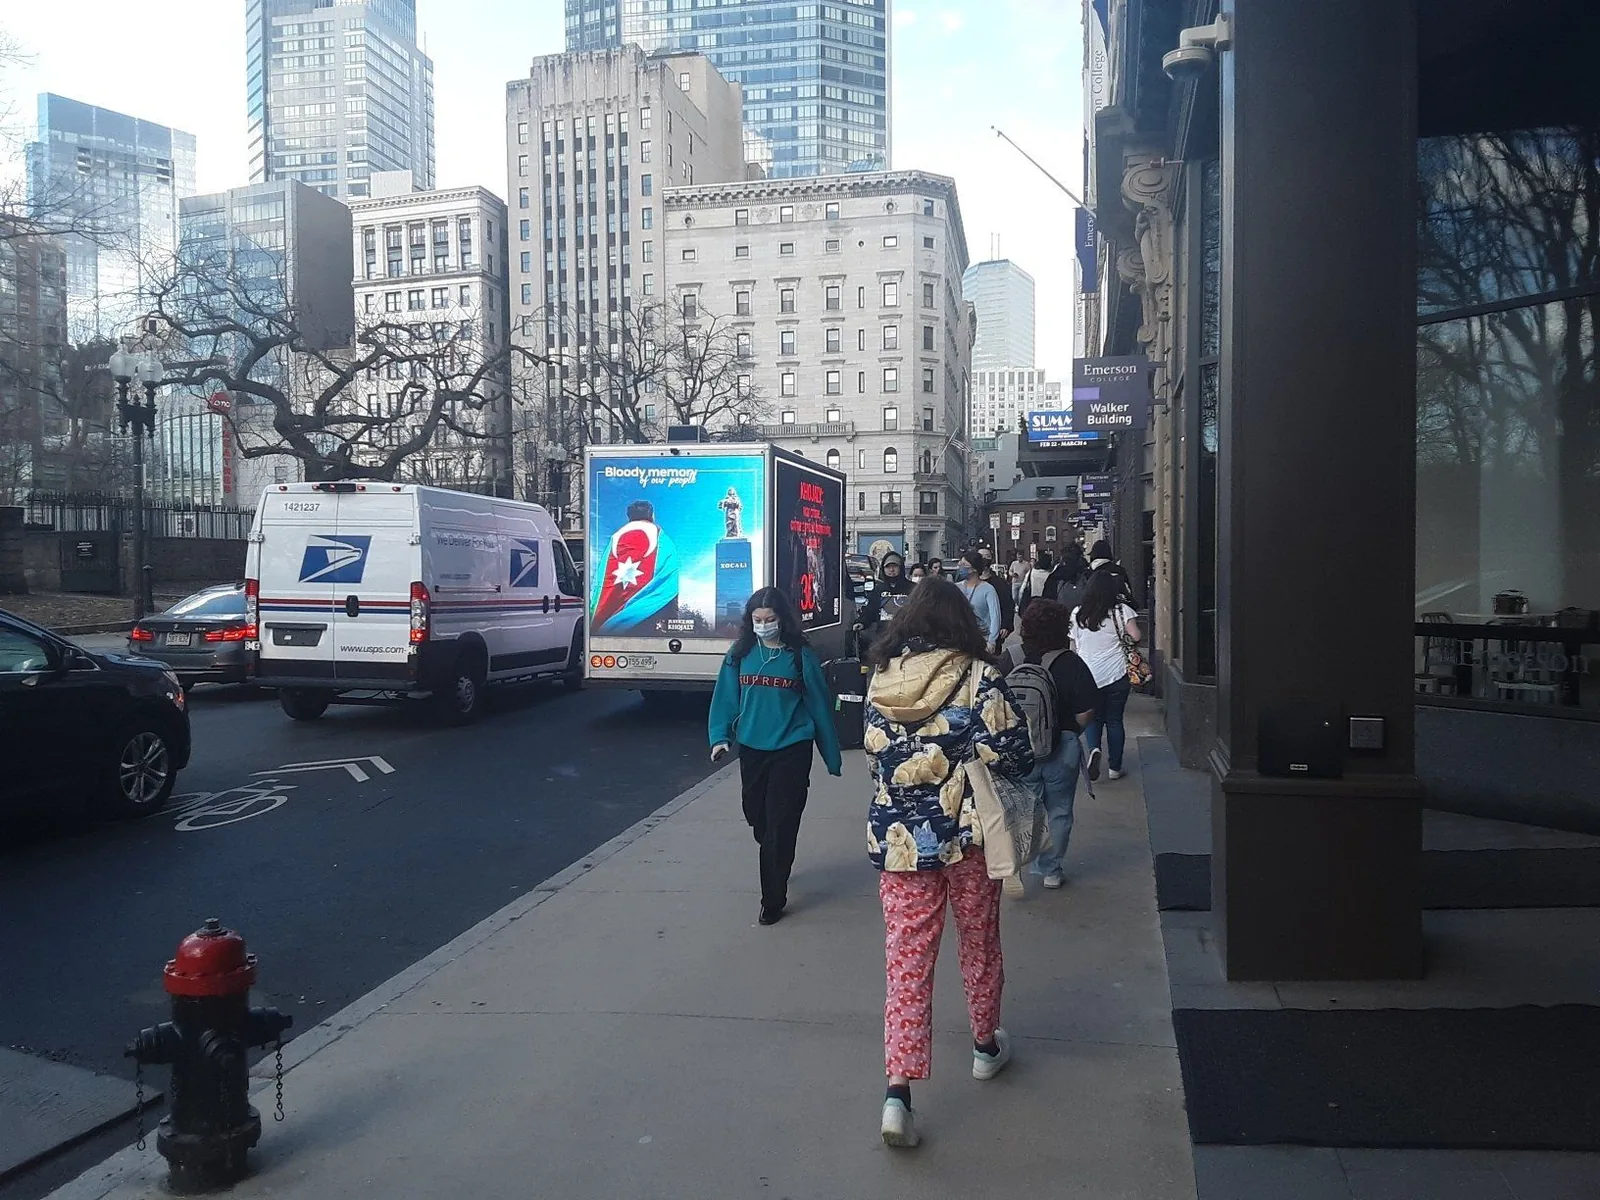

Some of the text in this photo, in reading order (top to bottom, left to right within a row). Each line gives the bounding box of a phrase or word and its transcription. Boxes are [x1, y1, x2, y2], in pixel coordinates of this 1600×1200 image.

[1091, 48, 1106, 95] College
[1083, 364, 1137, 376] Emerson
[1089, 402, 1130, 413] Walker
[1032, 415, 1073, 427] SUMM
[1087, 414, 1132, 426] Building
[604, 466, 699, 479] Bloody memory
[639, 475, 650, 488] of
[283, 503, 320, 512] 1421237
[340, 645, 404, 655] www.usps.com
